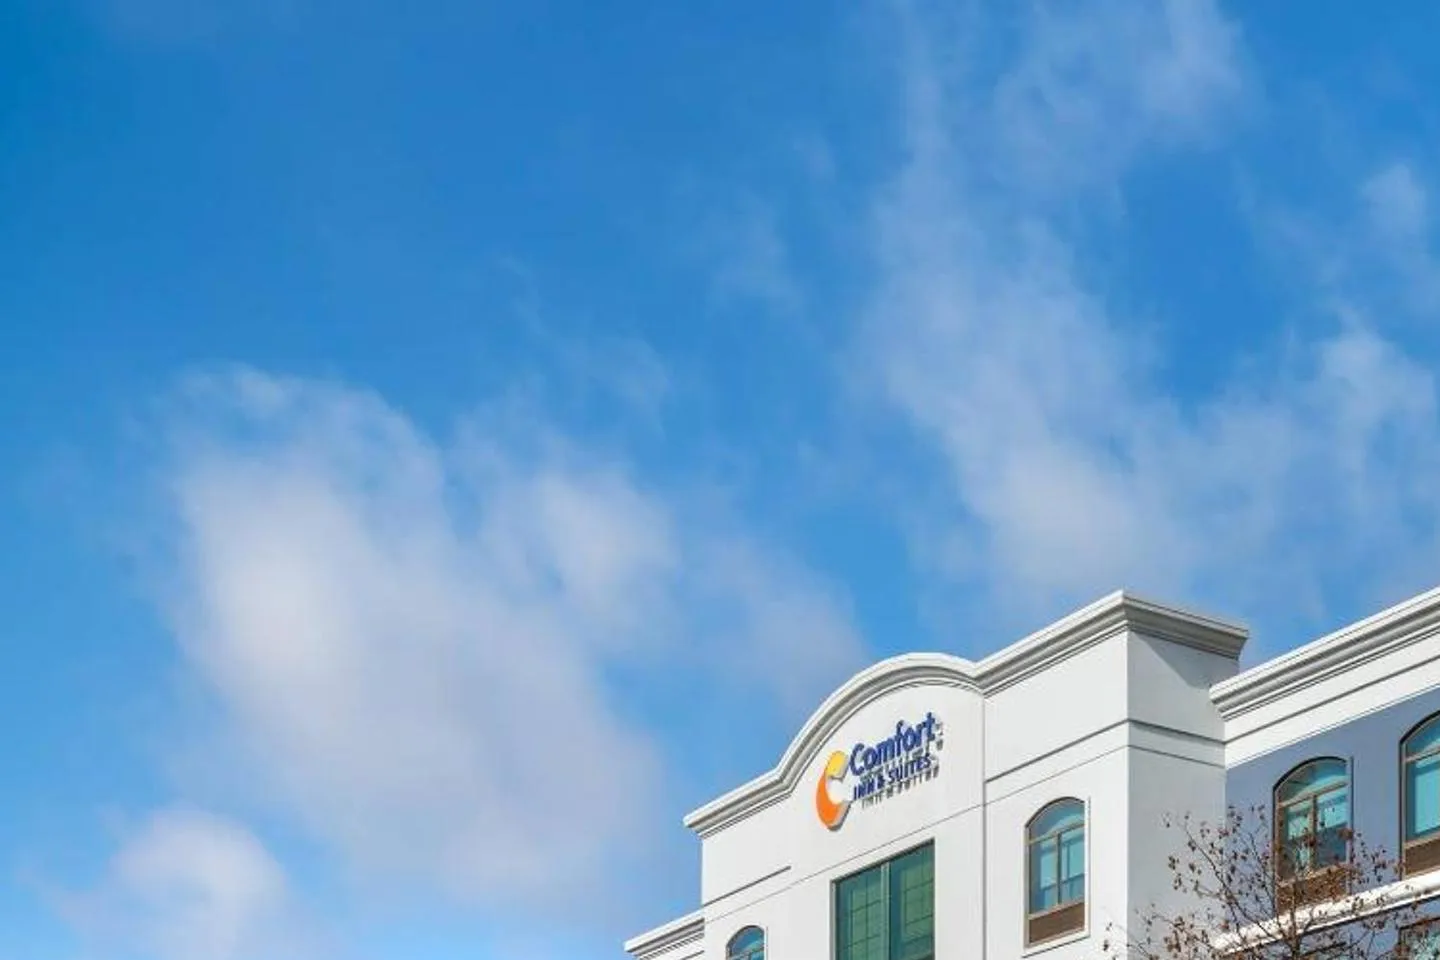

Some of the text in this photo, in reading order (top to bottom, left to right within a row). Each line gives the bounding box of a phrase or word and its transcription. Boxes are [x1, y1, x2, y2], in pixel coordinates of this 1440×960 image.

[850, 712, 935, 776] Comfort
[853, 778, 875, 800] INN
[887, 754, 931, 784] SUITES
